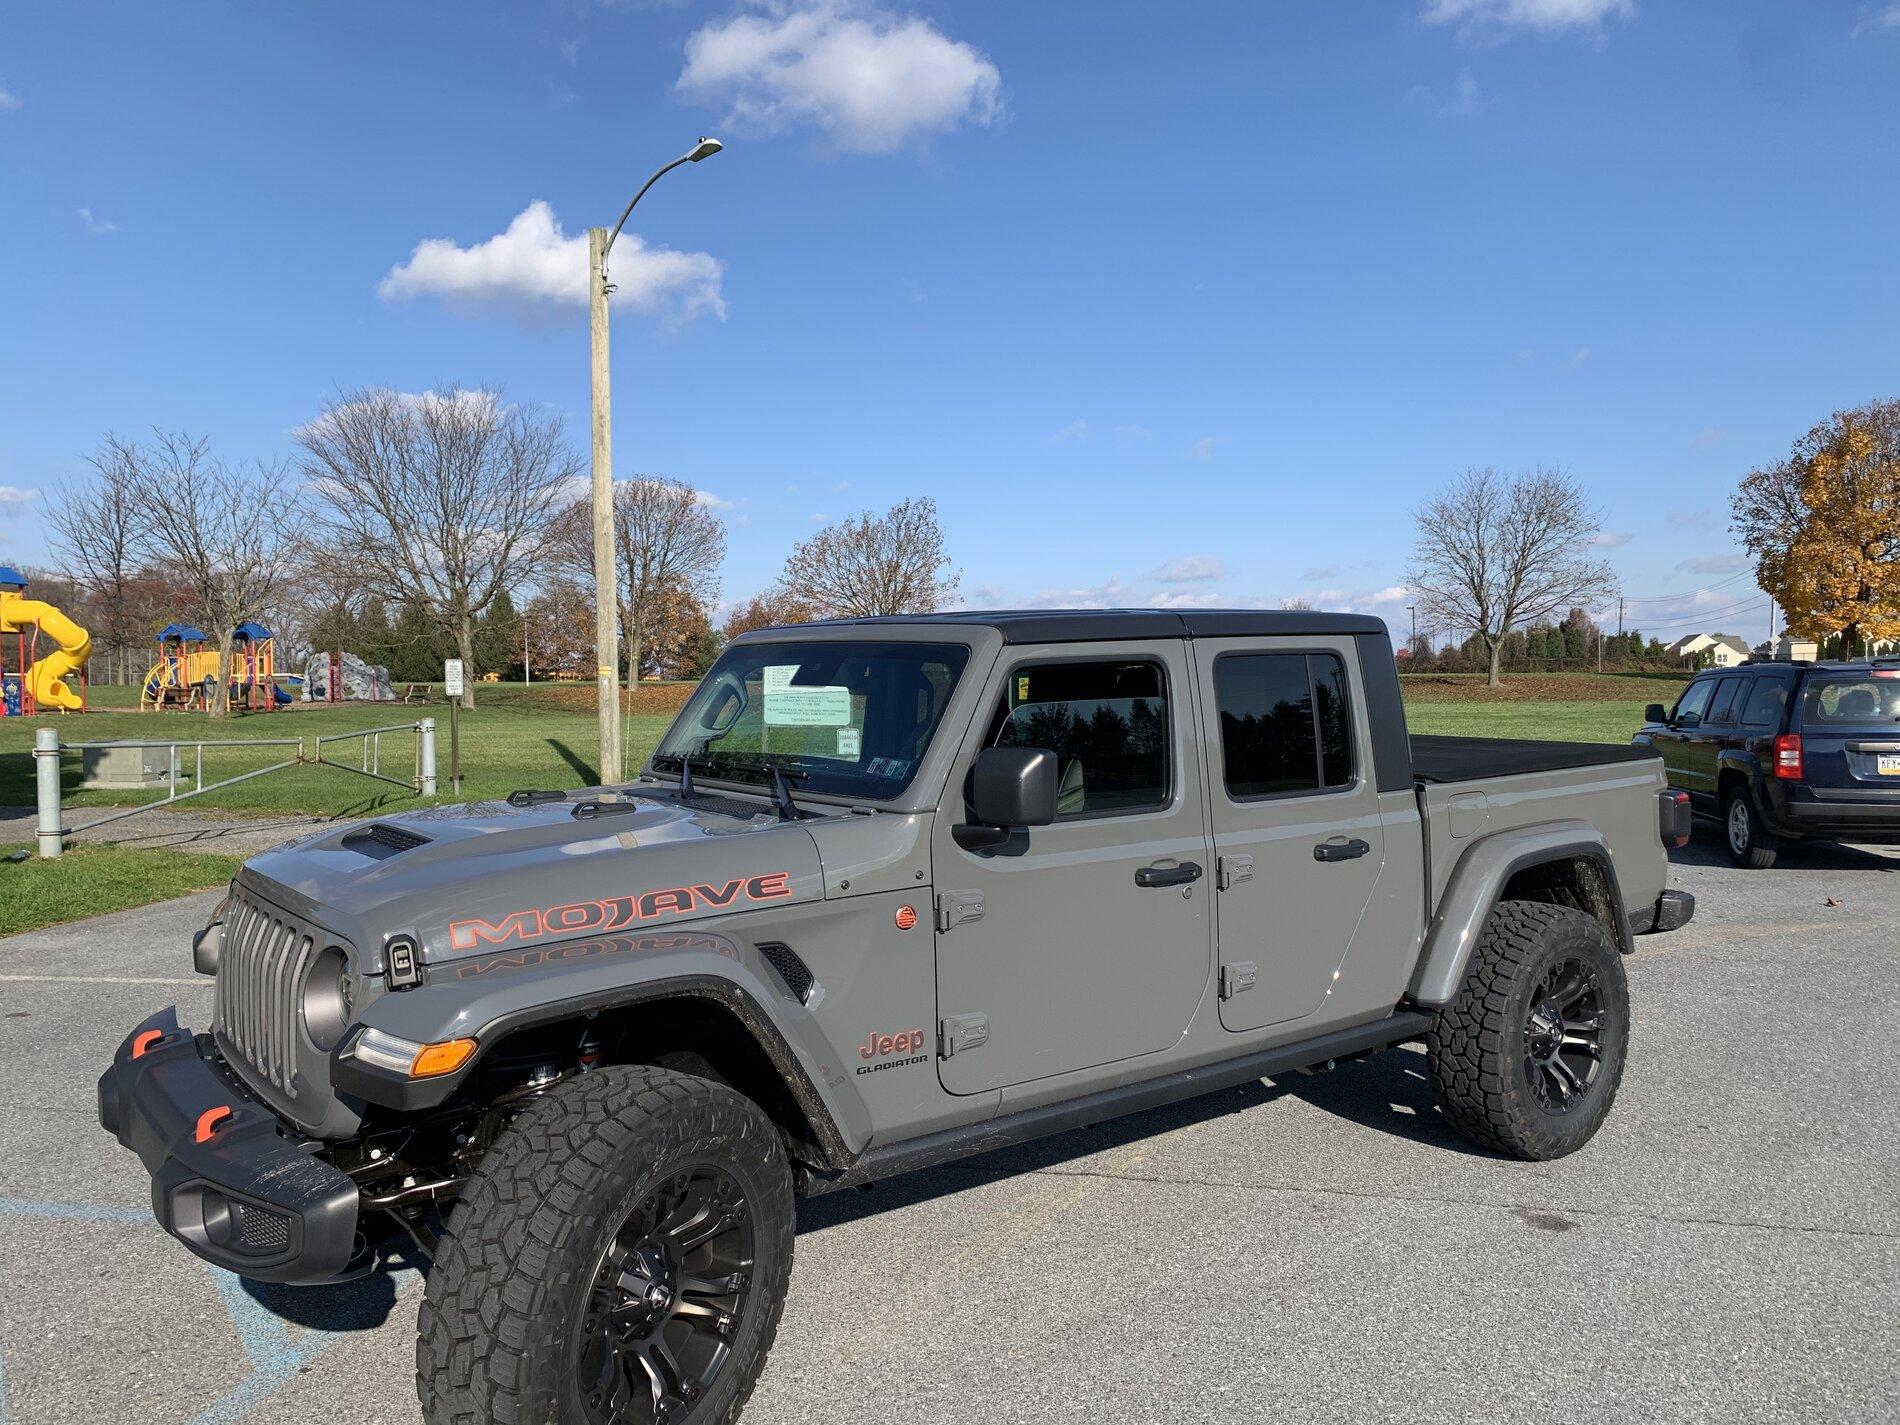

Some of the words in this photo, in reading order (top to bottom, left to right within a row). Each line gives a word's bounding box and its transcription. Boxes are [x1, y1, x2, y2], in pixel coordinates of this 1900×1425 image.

[450, 872, 792, 949] MOJAVE
[859, 1029, 925, 1059] Jeep
[856, 1055, 929, 1075] GLADIATOR
